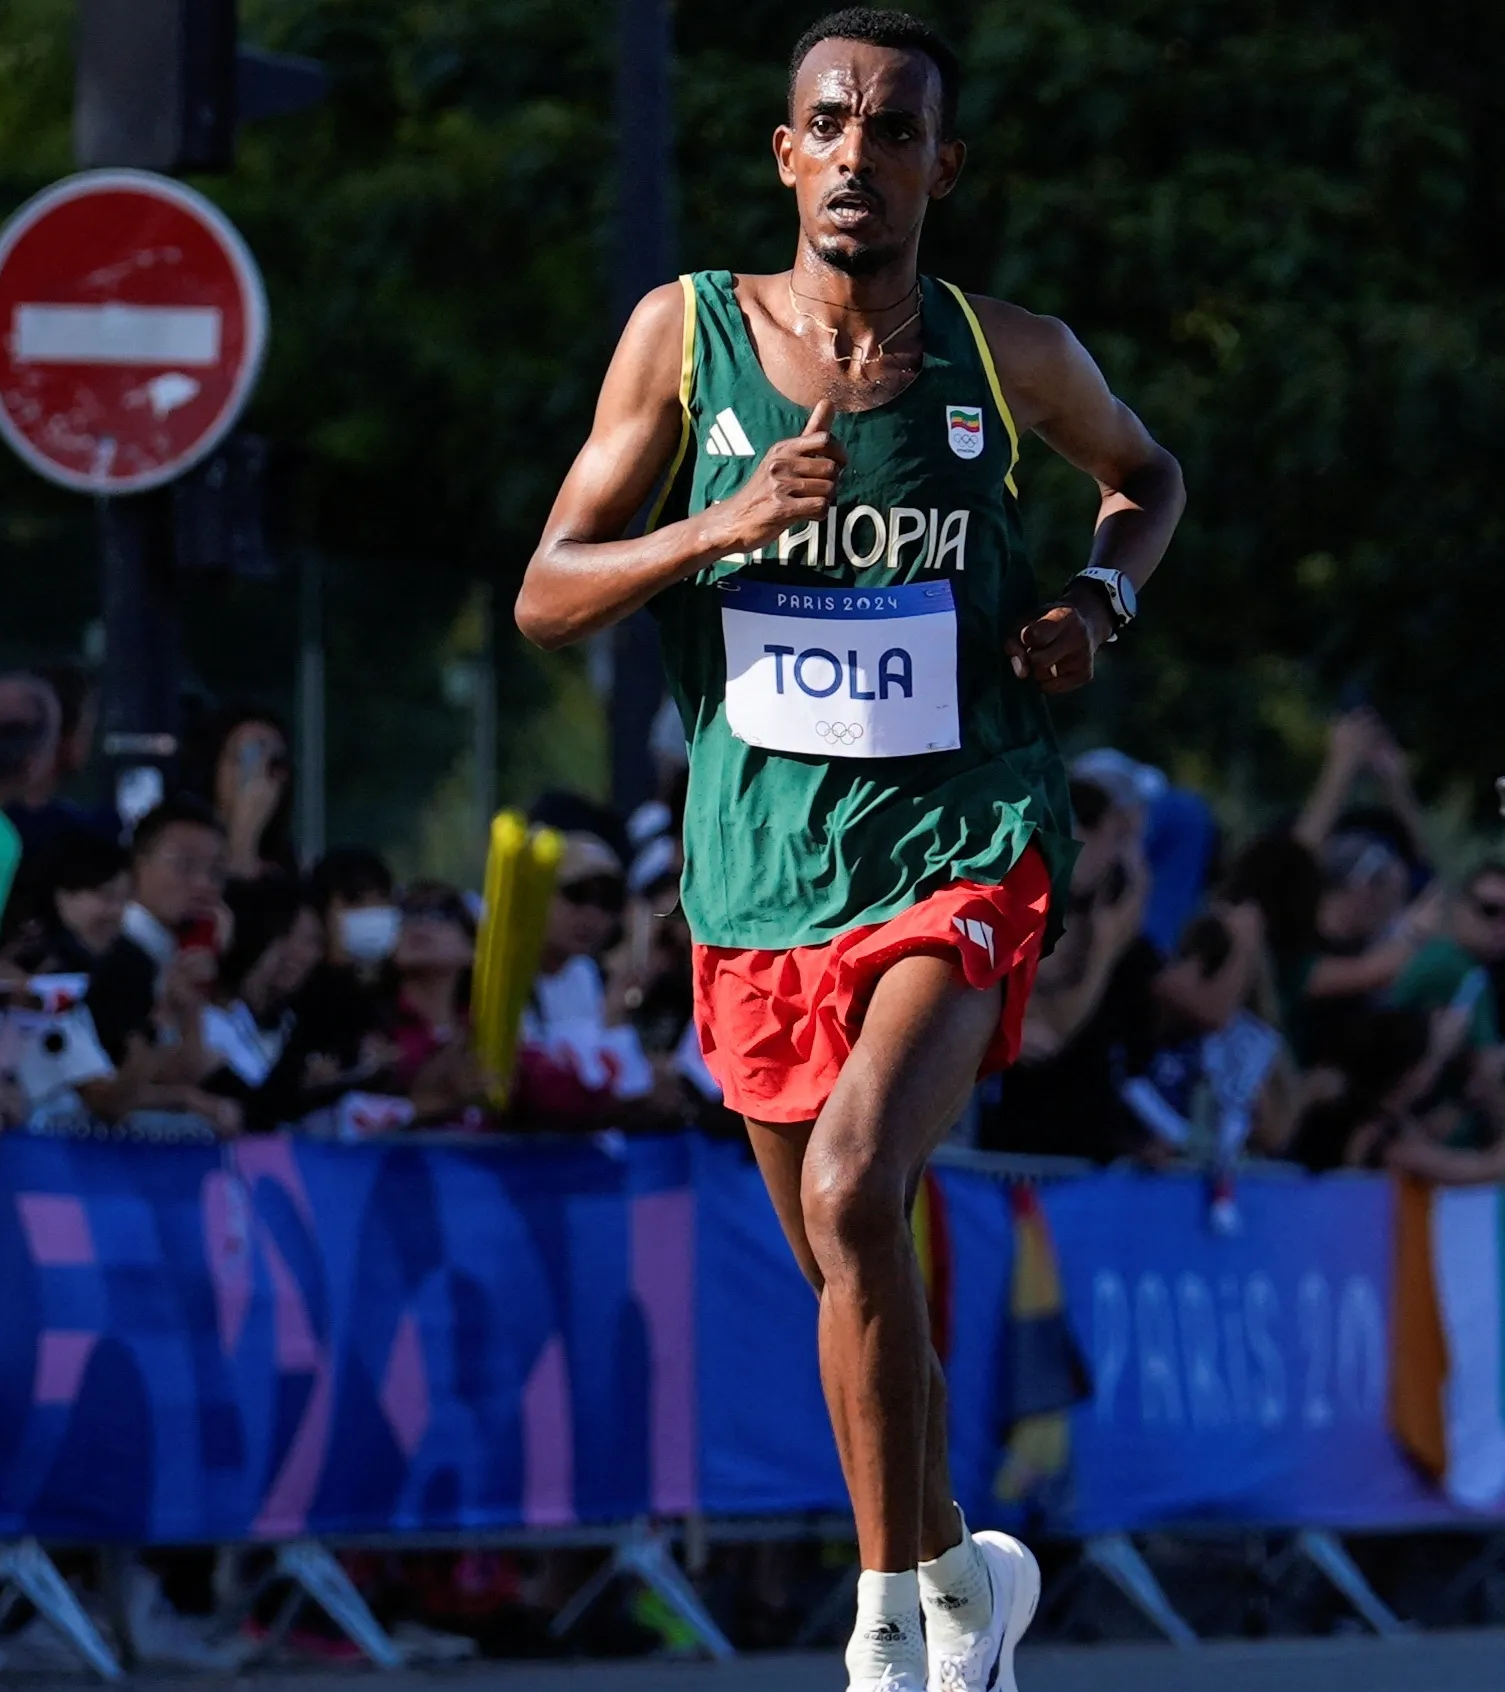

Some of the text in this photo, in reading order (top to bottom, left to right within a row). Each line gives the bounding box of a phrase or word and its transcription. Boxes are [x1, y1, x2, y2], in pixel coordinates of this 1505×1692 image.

[715, 501, 970, 571] HIOPIA
[777, 593, 898, 611] PARIS 2024
[764, 644, 913, 700] TOLA
